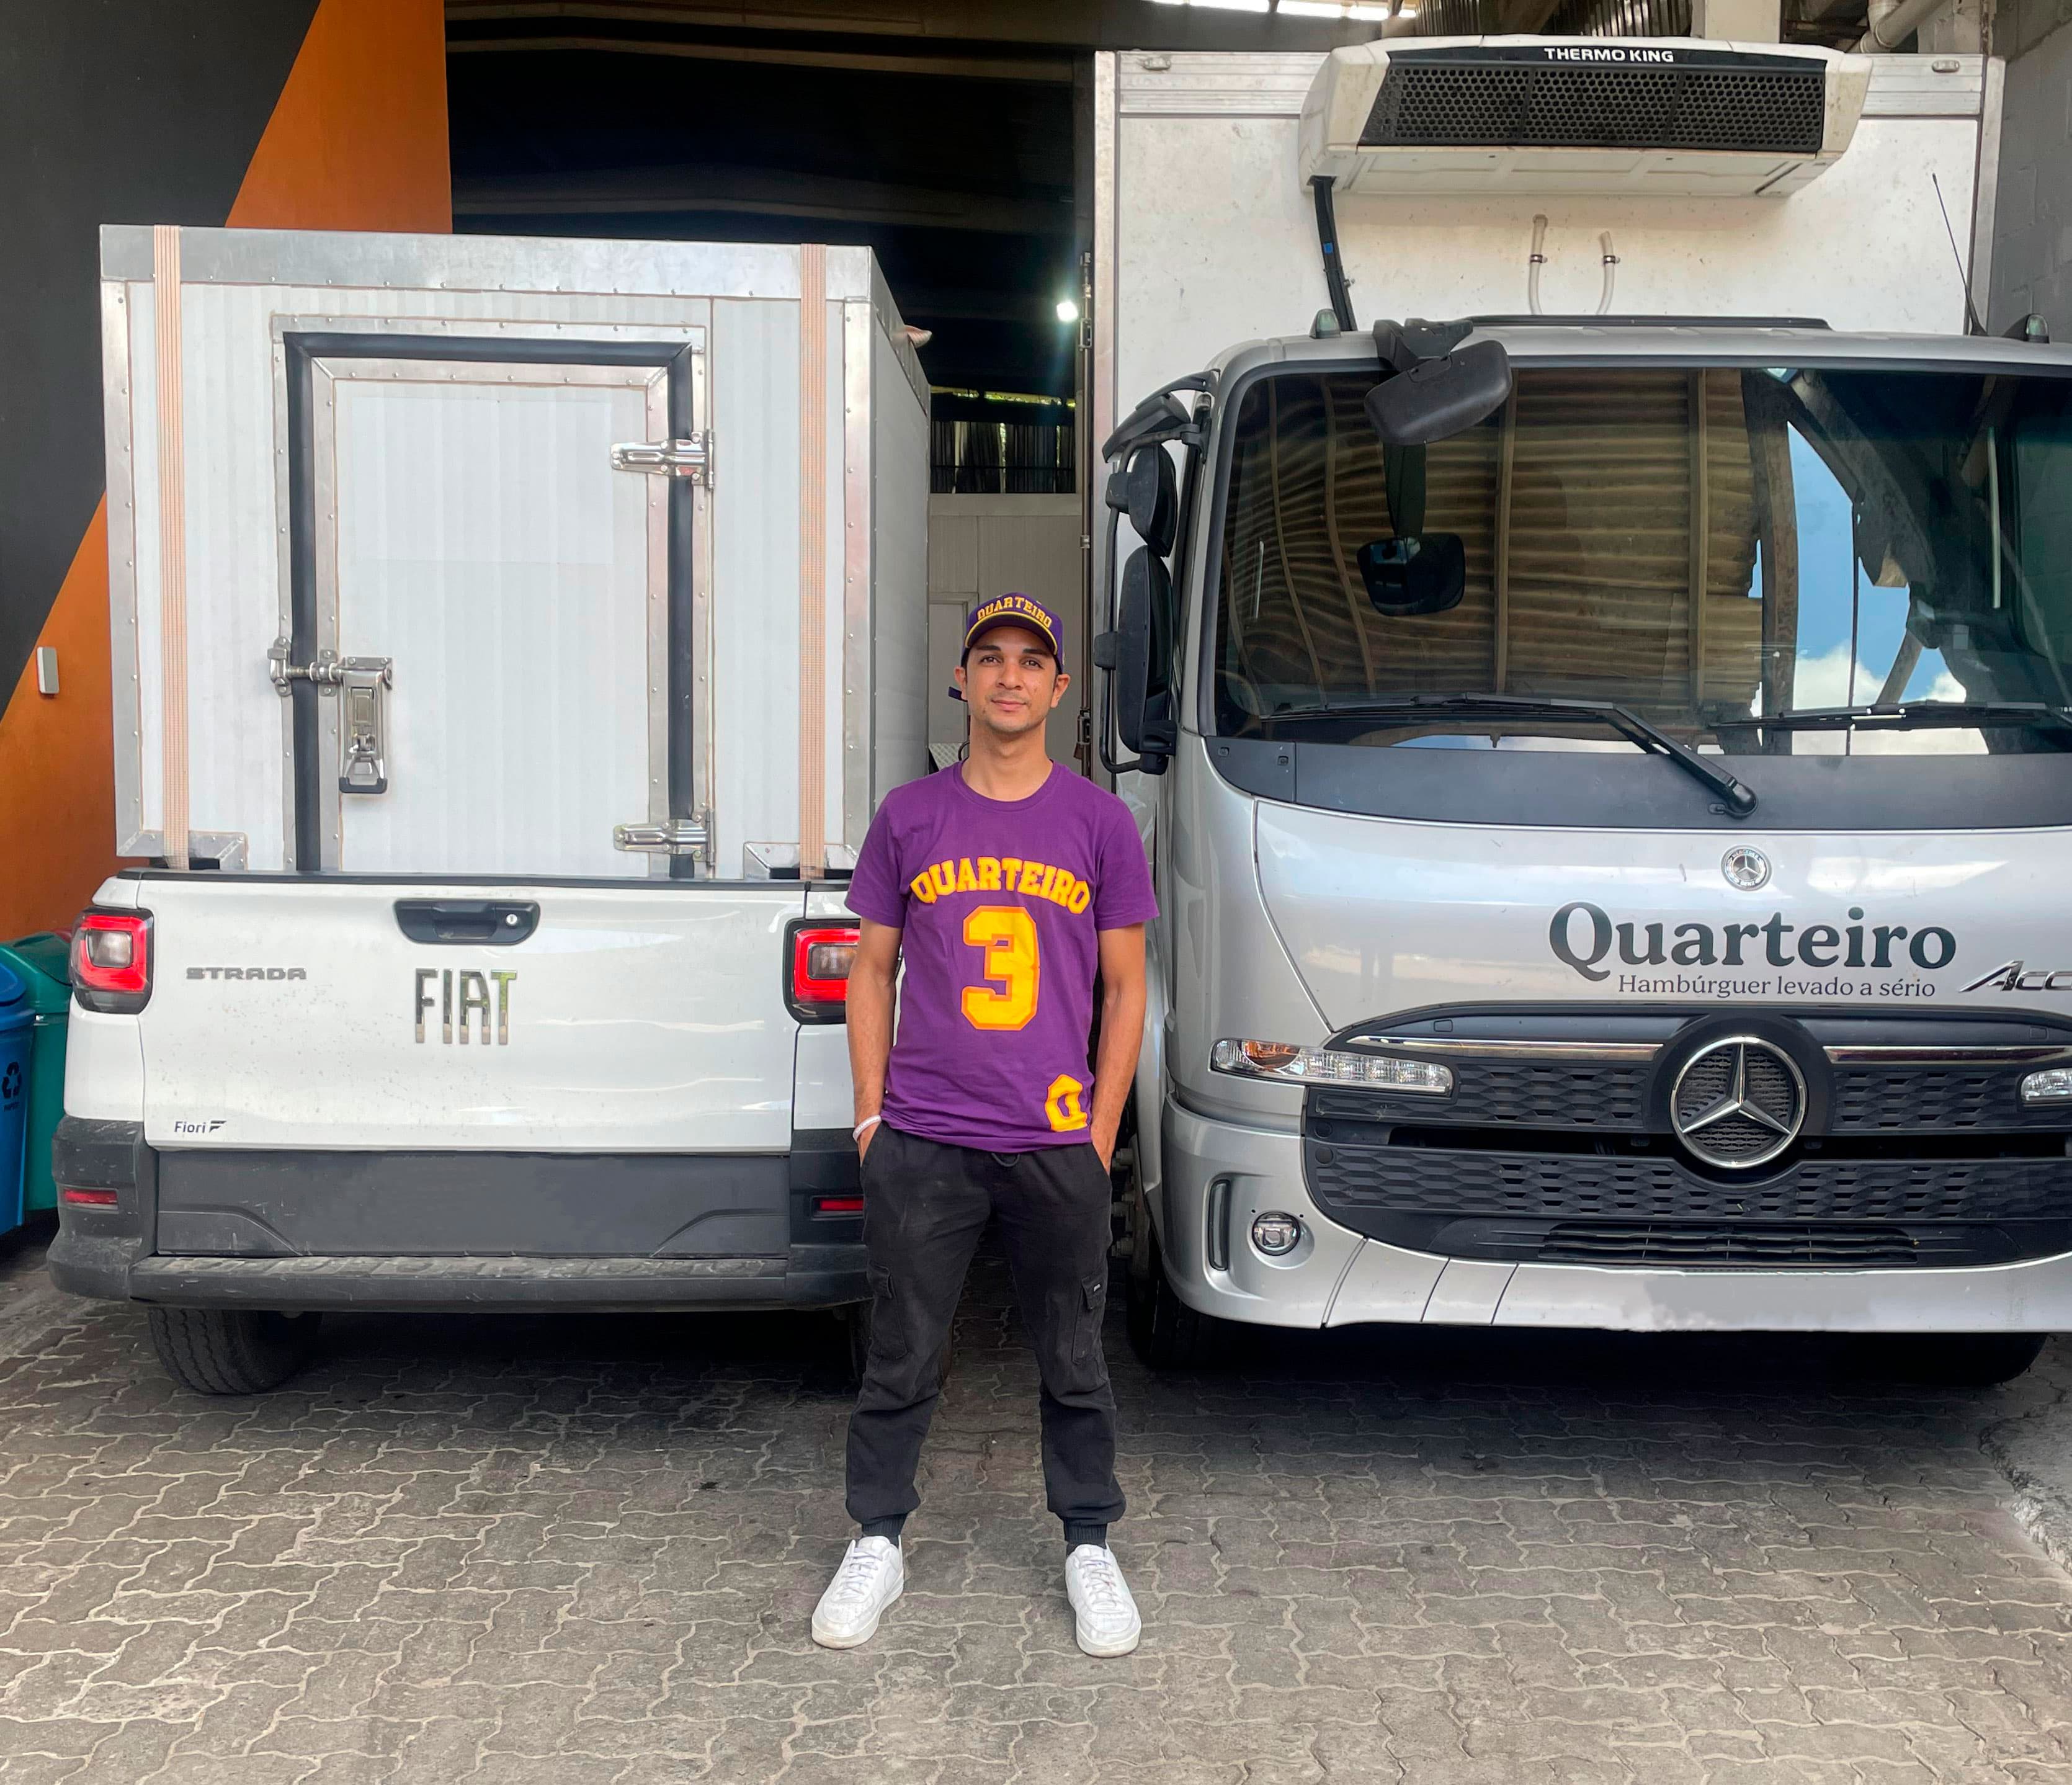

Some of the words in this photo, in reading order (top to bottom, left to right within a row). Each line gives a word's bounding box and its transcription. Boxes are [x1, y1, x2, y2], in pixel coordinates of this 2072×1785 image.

[1544, 48, 1625, 61] THERMO
[1630, 50, 1674, 62] KING
[976, 596, 1053, 629] QUARTEIRO
[909, 856, 1090, 915] QUARTEIRO
[1549, 901, 1957, 982] Quarteiro
[186, 967, 307, 980] STRADA
[961, 905, 1040, 1031] 3
[1619, 973, 1771, 998] Hambúrguer
[1777, 976, 1854, 995] levado
[1860, 982, 1872, 996] a
[1879, 978, 1936, 996] sério
[415, 969, 517, 1045] FIAT
[174, 1121, 207, 1134] Fiori
